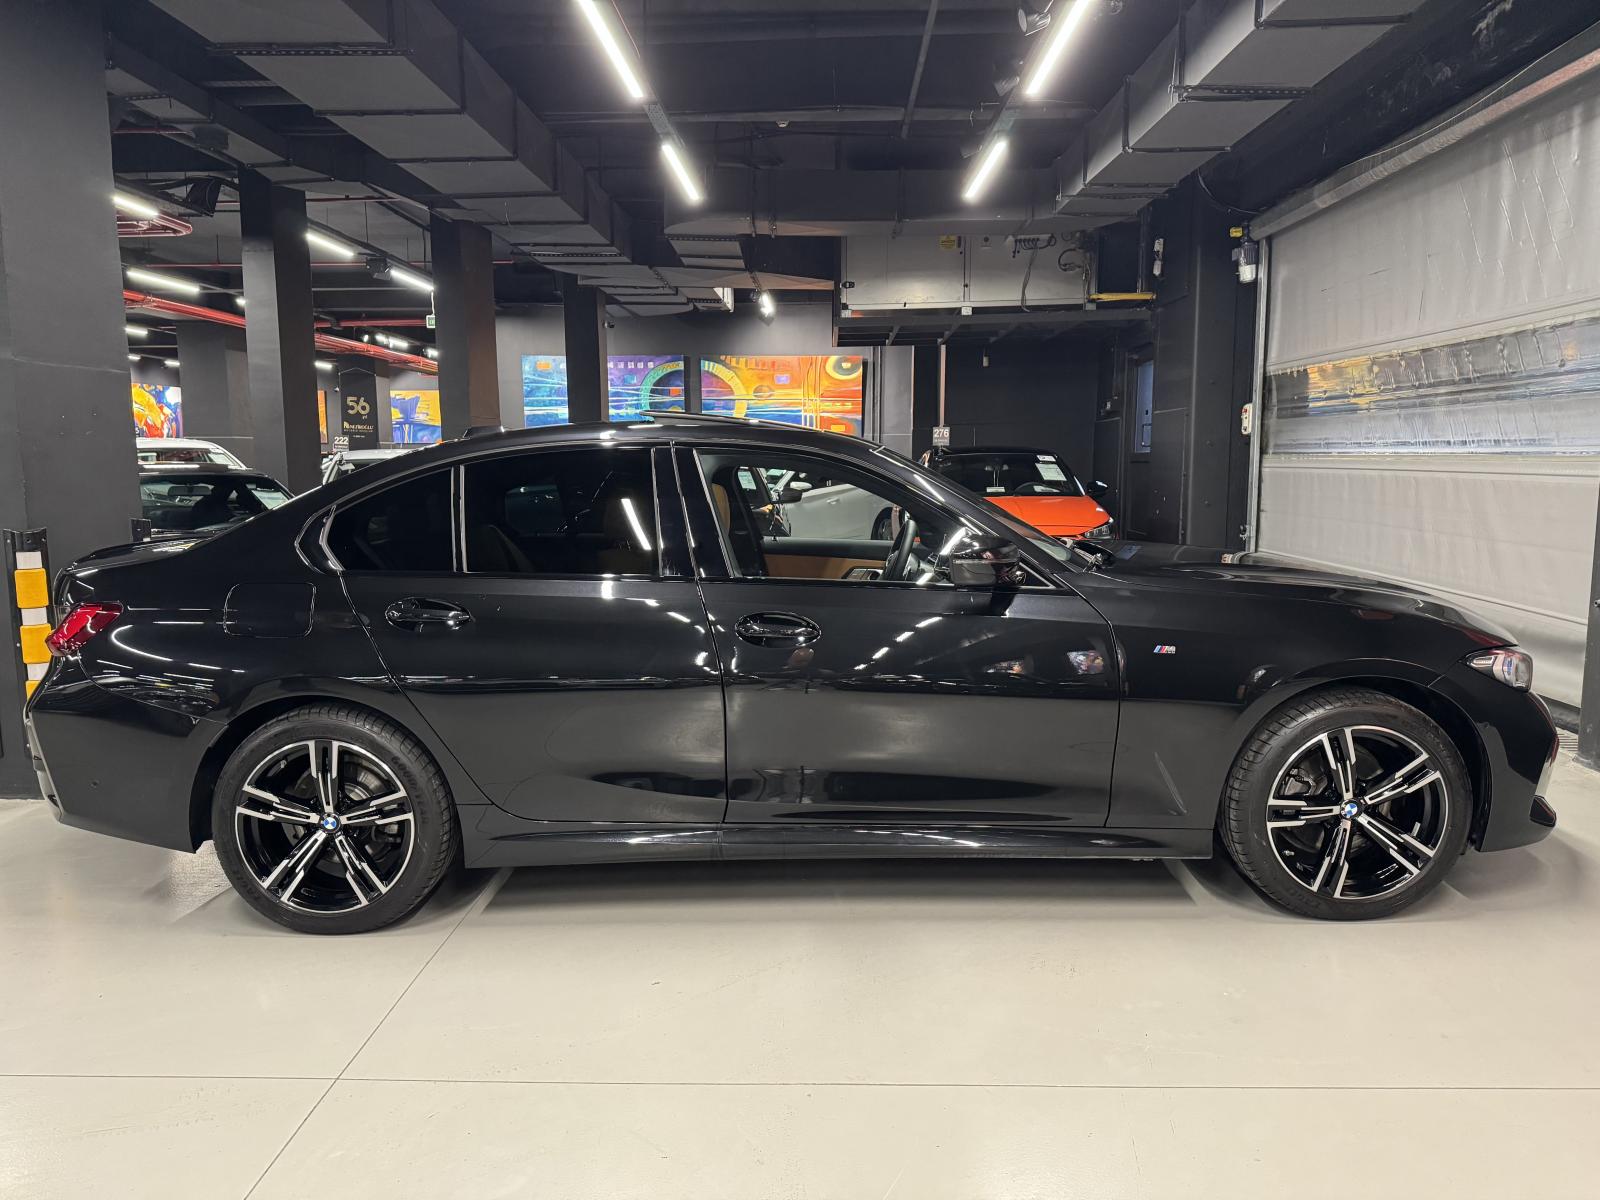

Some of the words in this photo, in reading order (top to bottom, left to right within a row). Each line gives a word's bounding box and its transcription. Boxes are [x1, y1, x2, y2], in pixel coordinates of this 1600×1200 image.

[346, 396, 370, 415] 56
[934, 428, 949, 438] 276
[334, 436, 349, 444] 222
